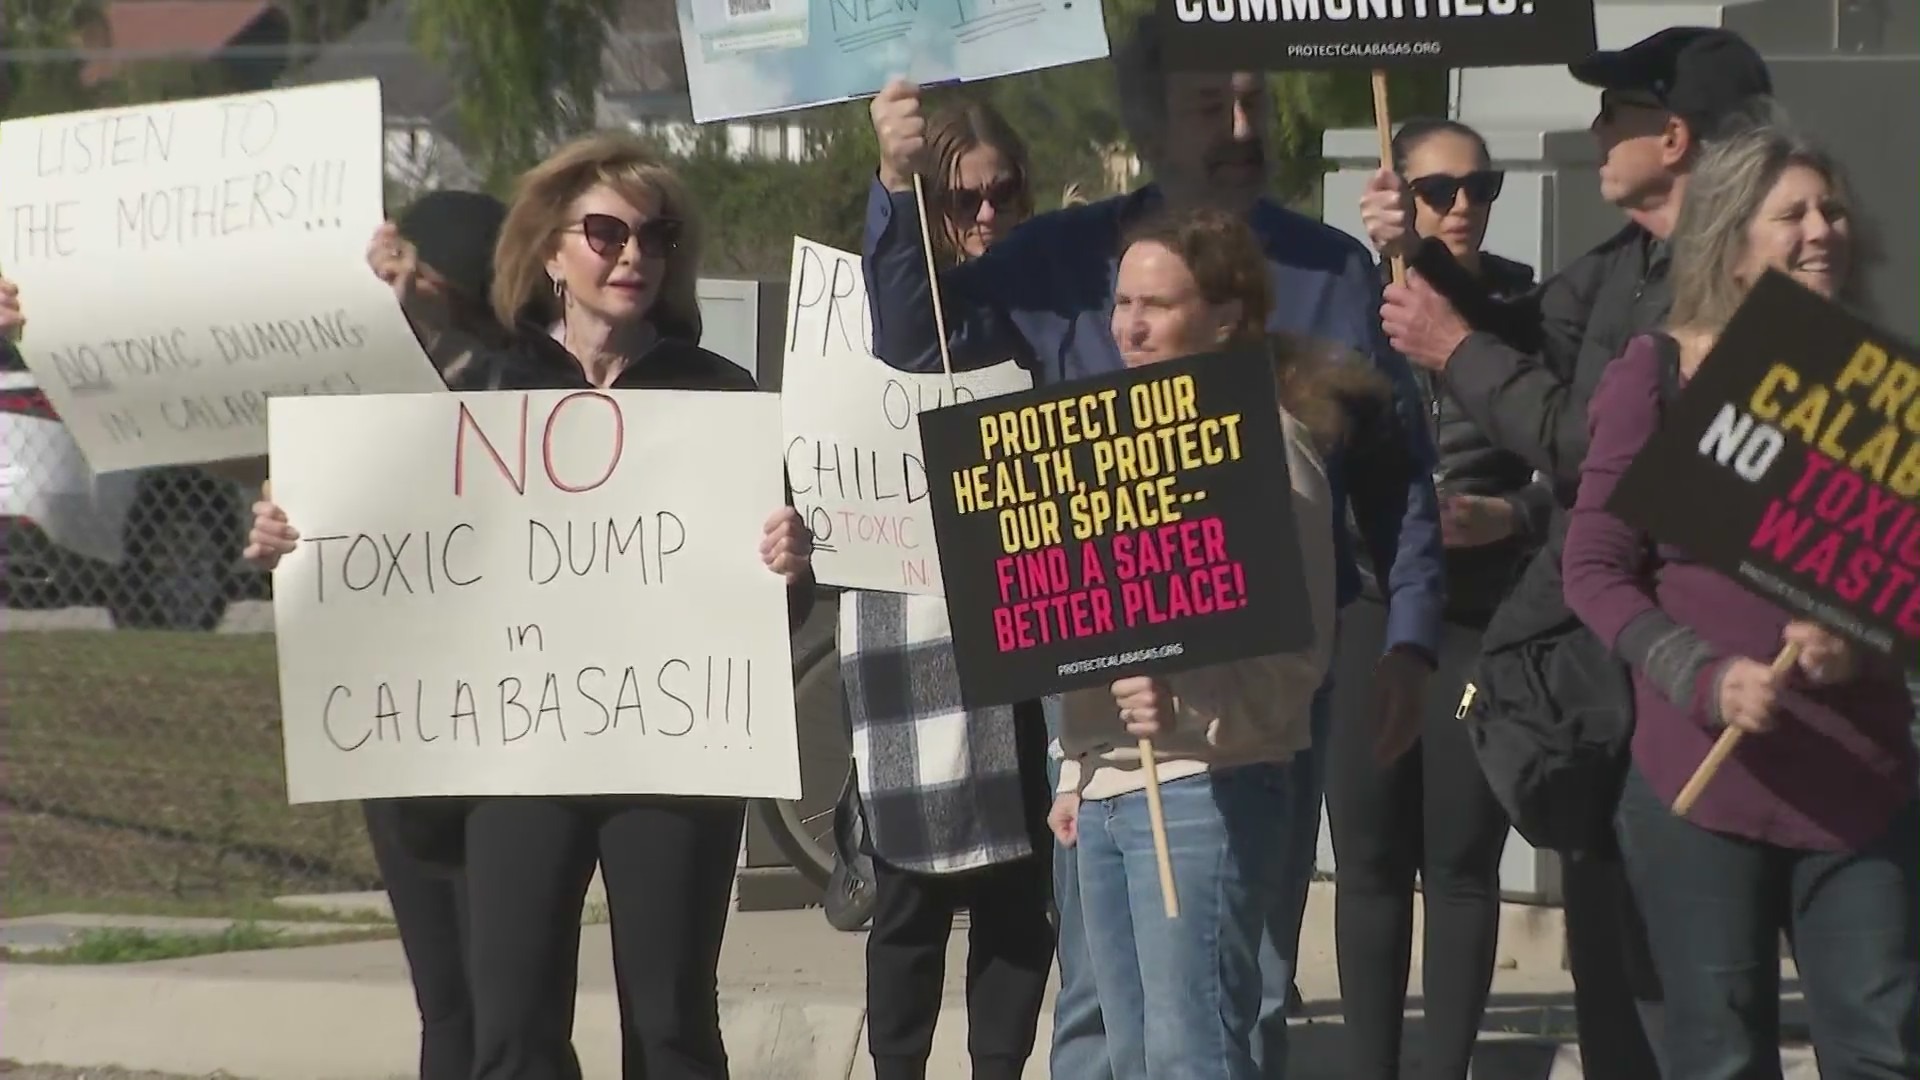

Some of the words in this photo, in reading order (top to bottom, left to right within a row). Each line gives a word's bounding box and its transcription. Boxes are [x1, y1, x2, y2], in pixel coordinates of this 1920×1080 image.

[1287, 42, 1442, 57] PROTECTCALABASAS.ORG
[37, 112, 177, 178] LISTEN
[217, 99, 279, 159] TO
[11, 200, 81, 264] THE
[117, 159, 347, 250] MOTHERS!!!
[51, 344, 108, 388] NO
[104, 327, 201, 375] TOXIC
[210, 310, 366, 365] DUMPING
[101, 411, 142, 443] IN
[454, 391, 625, 497] NO
[978, 388, 1119, 461] PROTECT
[1128, 374, 1198, 431] OUR
[1698, 402, 1786, 482] NO
[952, 447, 1088, 515] HEALTH,
[1093, 413, 1243, 487] PROTECT
[303, 522, 484, 603] TOXIC
[527, 510, 687, 586] DUMP
[837, 510, 920, 550] TOXIC
[998, 500, 1062, 555] OUR
[1069, 476, 1207, 541] SPACE--
[995, 547, 1070, 603] FIND
[1080, 541, 1106, 588] A
[1111, 517, 1229, 580] SAFER
[506, 623, 544, 652] in
[992, 588, 1116, 652] BETTER
[1121, 562, 1249, 628] PLACE!
[322, 655, 755, 752] CALABASAS!!!
